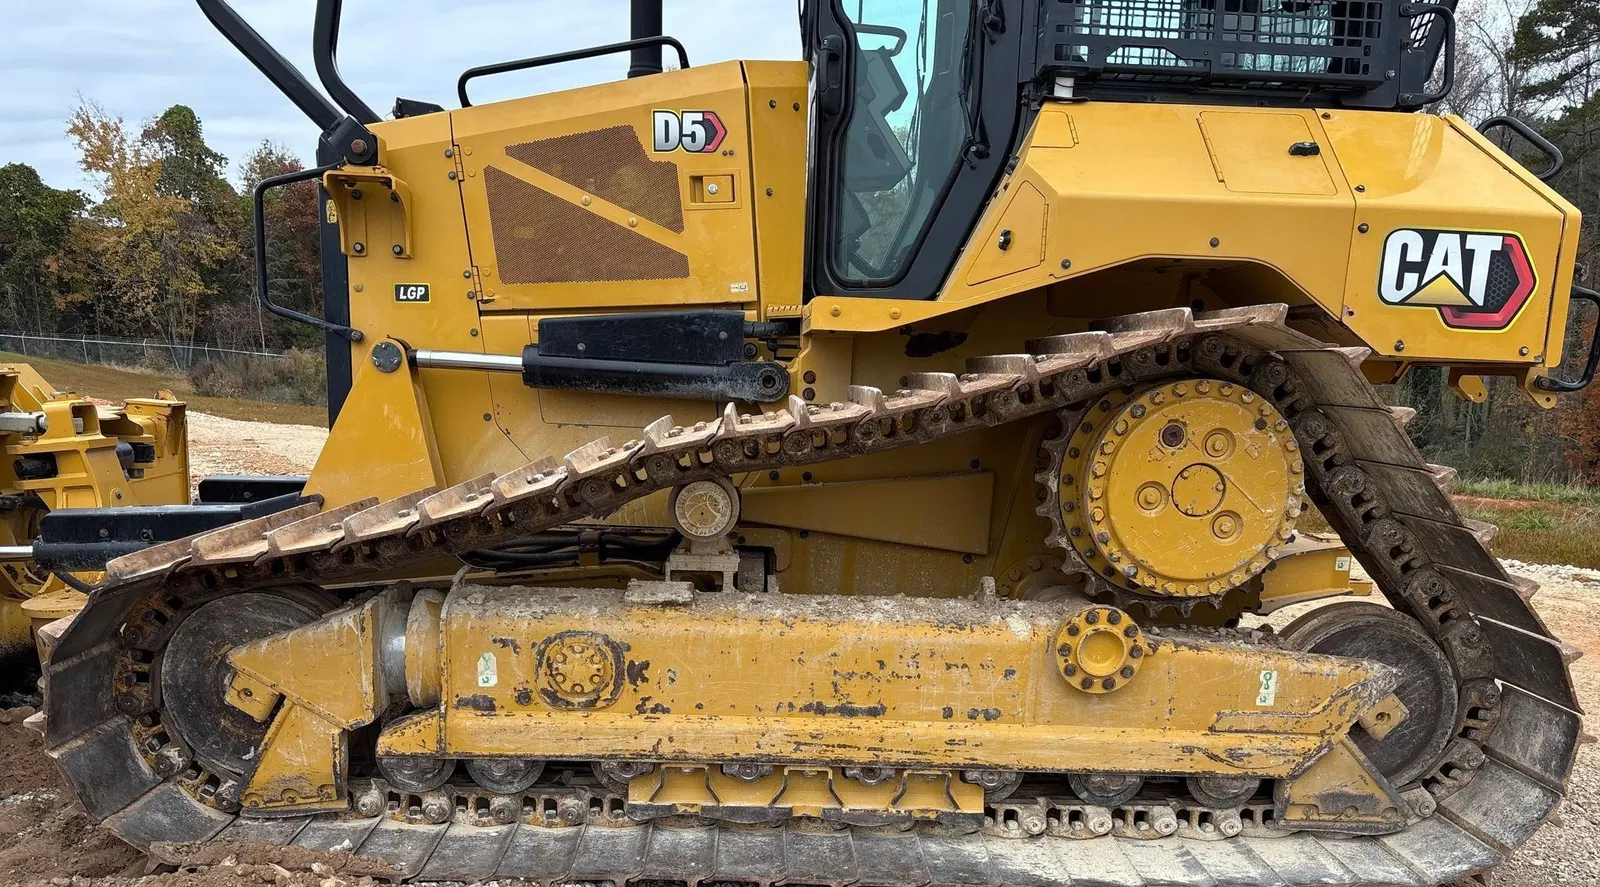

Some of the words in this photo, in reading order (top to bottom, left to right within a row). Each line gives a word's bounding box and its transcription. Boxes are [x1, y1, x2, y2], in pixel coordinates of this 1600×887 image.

[654, 112, 706, 152] D5
[1380, 229, 1503, 306] CAT
[399, 286, 426, 300] LGP
